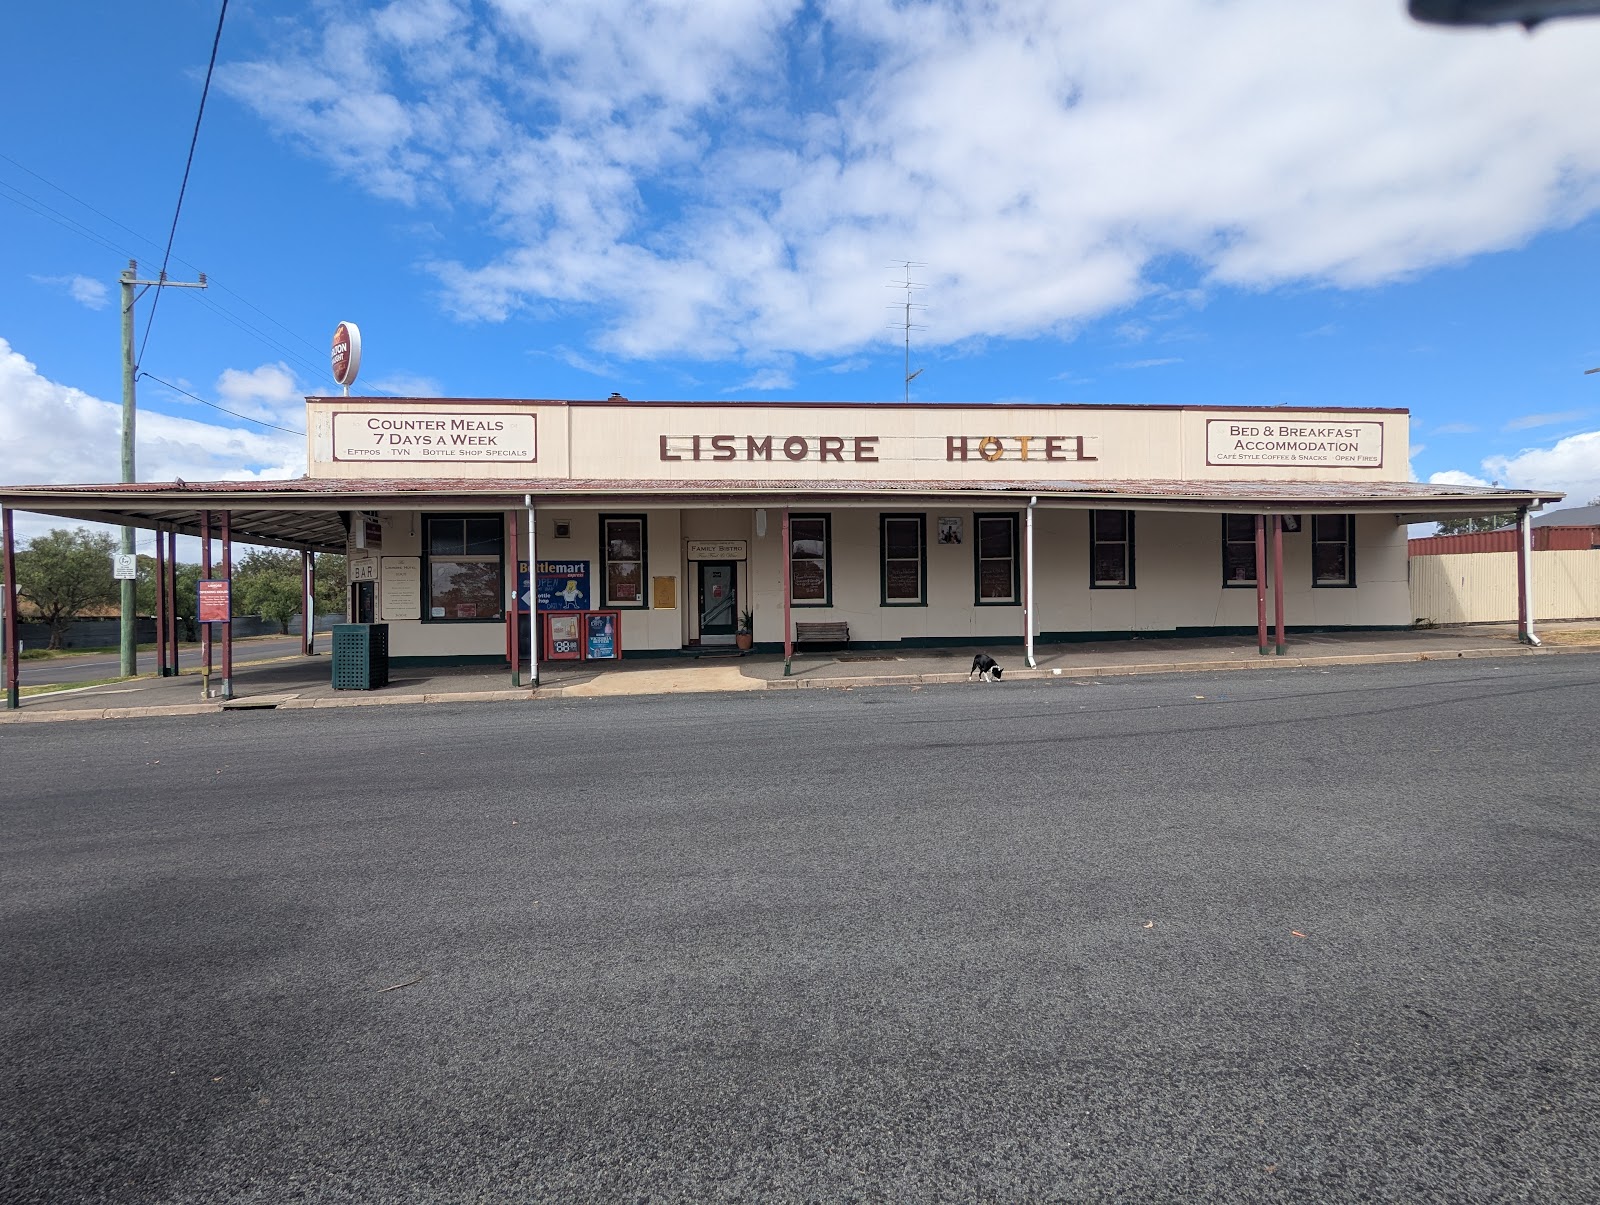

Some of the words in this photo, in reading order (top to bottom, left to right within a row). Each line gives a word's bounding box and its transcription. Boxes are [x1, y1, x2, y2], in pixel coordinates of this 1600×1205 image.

[367, 418, 446, 430] COUNTER
[450, 419, 504, 431] MEALS
[1230, 426, 1259, 437] BED
[1263, 426, 1274, 437] &
[1279, 427, 1361, 438] BREAKFAST
[373, 433, 384, 445] 7
[389, 433, 432, 445] DAYS
[436, 435, 447, 445] A
[450, 434, 498, 446] WEEK
[1233, 439, 1359, 452] ACCOMMODATION
[347, 448, 381, 456] EFTPOS
[391, 448, 411, 456] TVN
[422, 448, 456, 456] BOTTLE
[485, 449, 527, 457] SPECIALS
[659, 435, 879, 461] LISMORE
[946, 435, 1098, 461] HOTEL
[355, 566, 373, 578] BAR
[520, 562, 585, 573] Bttlemart
